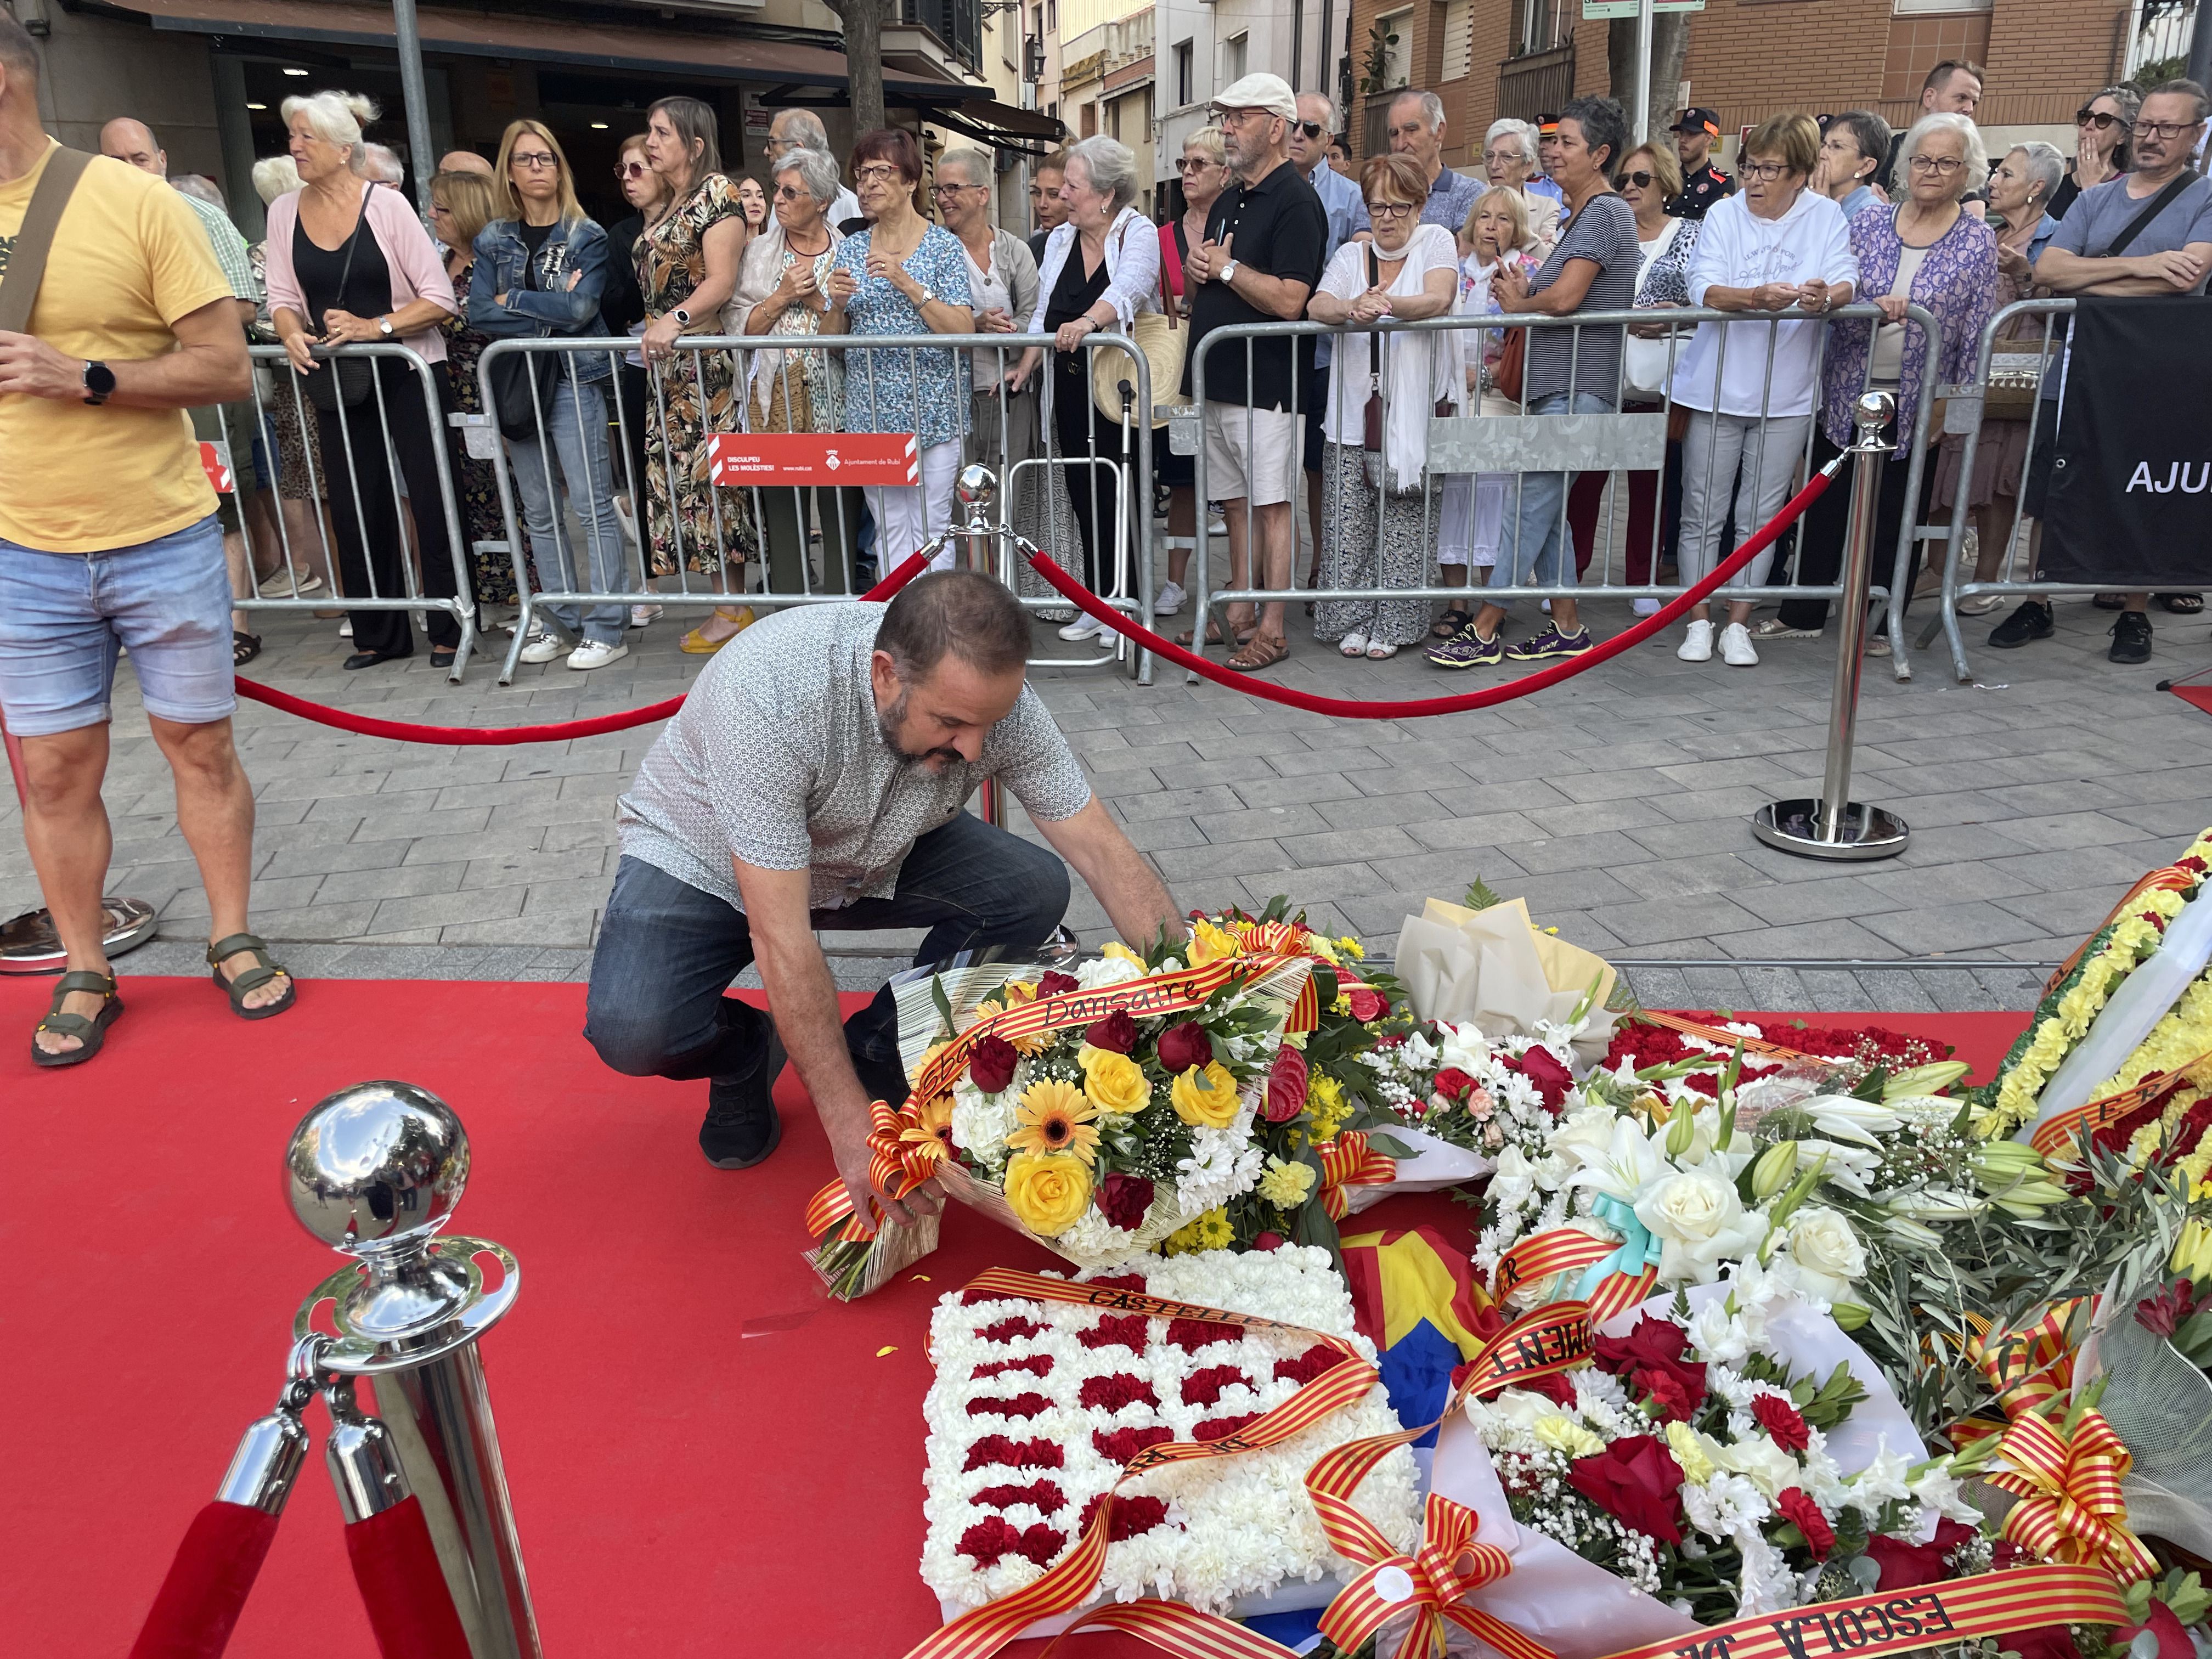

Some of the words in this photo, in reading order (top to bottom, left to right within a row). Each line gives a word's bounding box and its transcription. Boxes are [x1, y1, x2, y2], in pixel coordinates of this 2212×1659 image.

[1781, 249, 1795, 260] FOR
[2125, 461, 2212, 493] AJU
[1043, 979, 1200, 1027] Dansaire
[1770, 1593, 1955, 1659] ESCOLA
